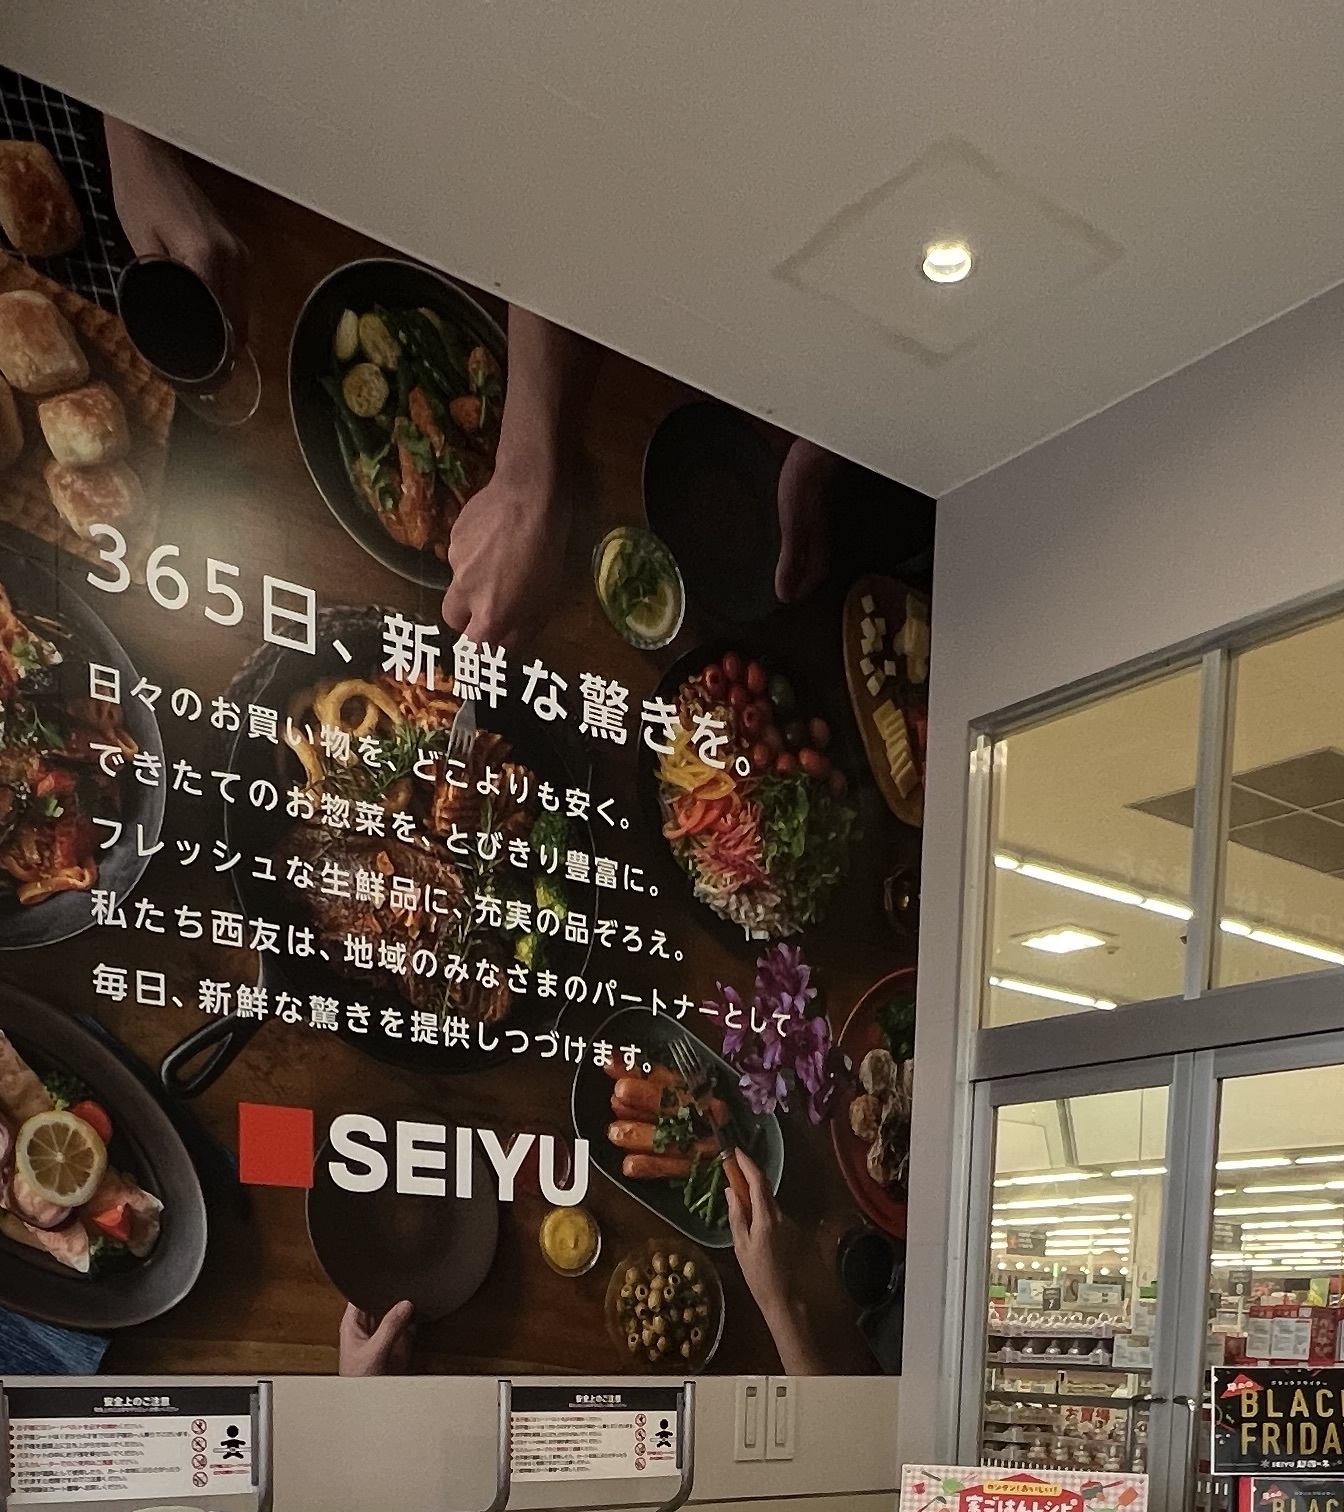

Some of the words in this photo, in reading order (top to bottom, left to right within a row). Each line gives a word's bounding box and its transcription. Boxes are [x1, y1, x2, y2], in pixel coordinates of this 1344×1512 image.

[85, 522, 754, 780] 365日、新鮮な驚きを。
[87, 662, 632, 832] 日々のお買い物を、どこよりも安く。
[89, 740, 659, 897] できたてのお惣菜を、とびきり豊富に。
[90, 889, 793, 1038] 私たち西友は、地域のみなさまのパートナーとして
[91, 817, 684, 961] フレッシュな生鮮品に、充実の品ぞろえ。
[91, 961, 654, 1075] 毎日、新鮮な驚きを提供しつづけます。
[327, 1112, 590, 1205] SEIYU
